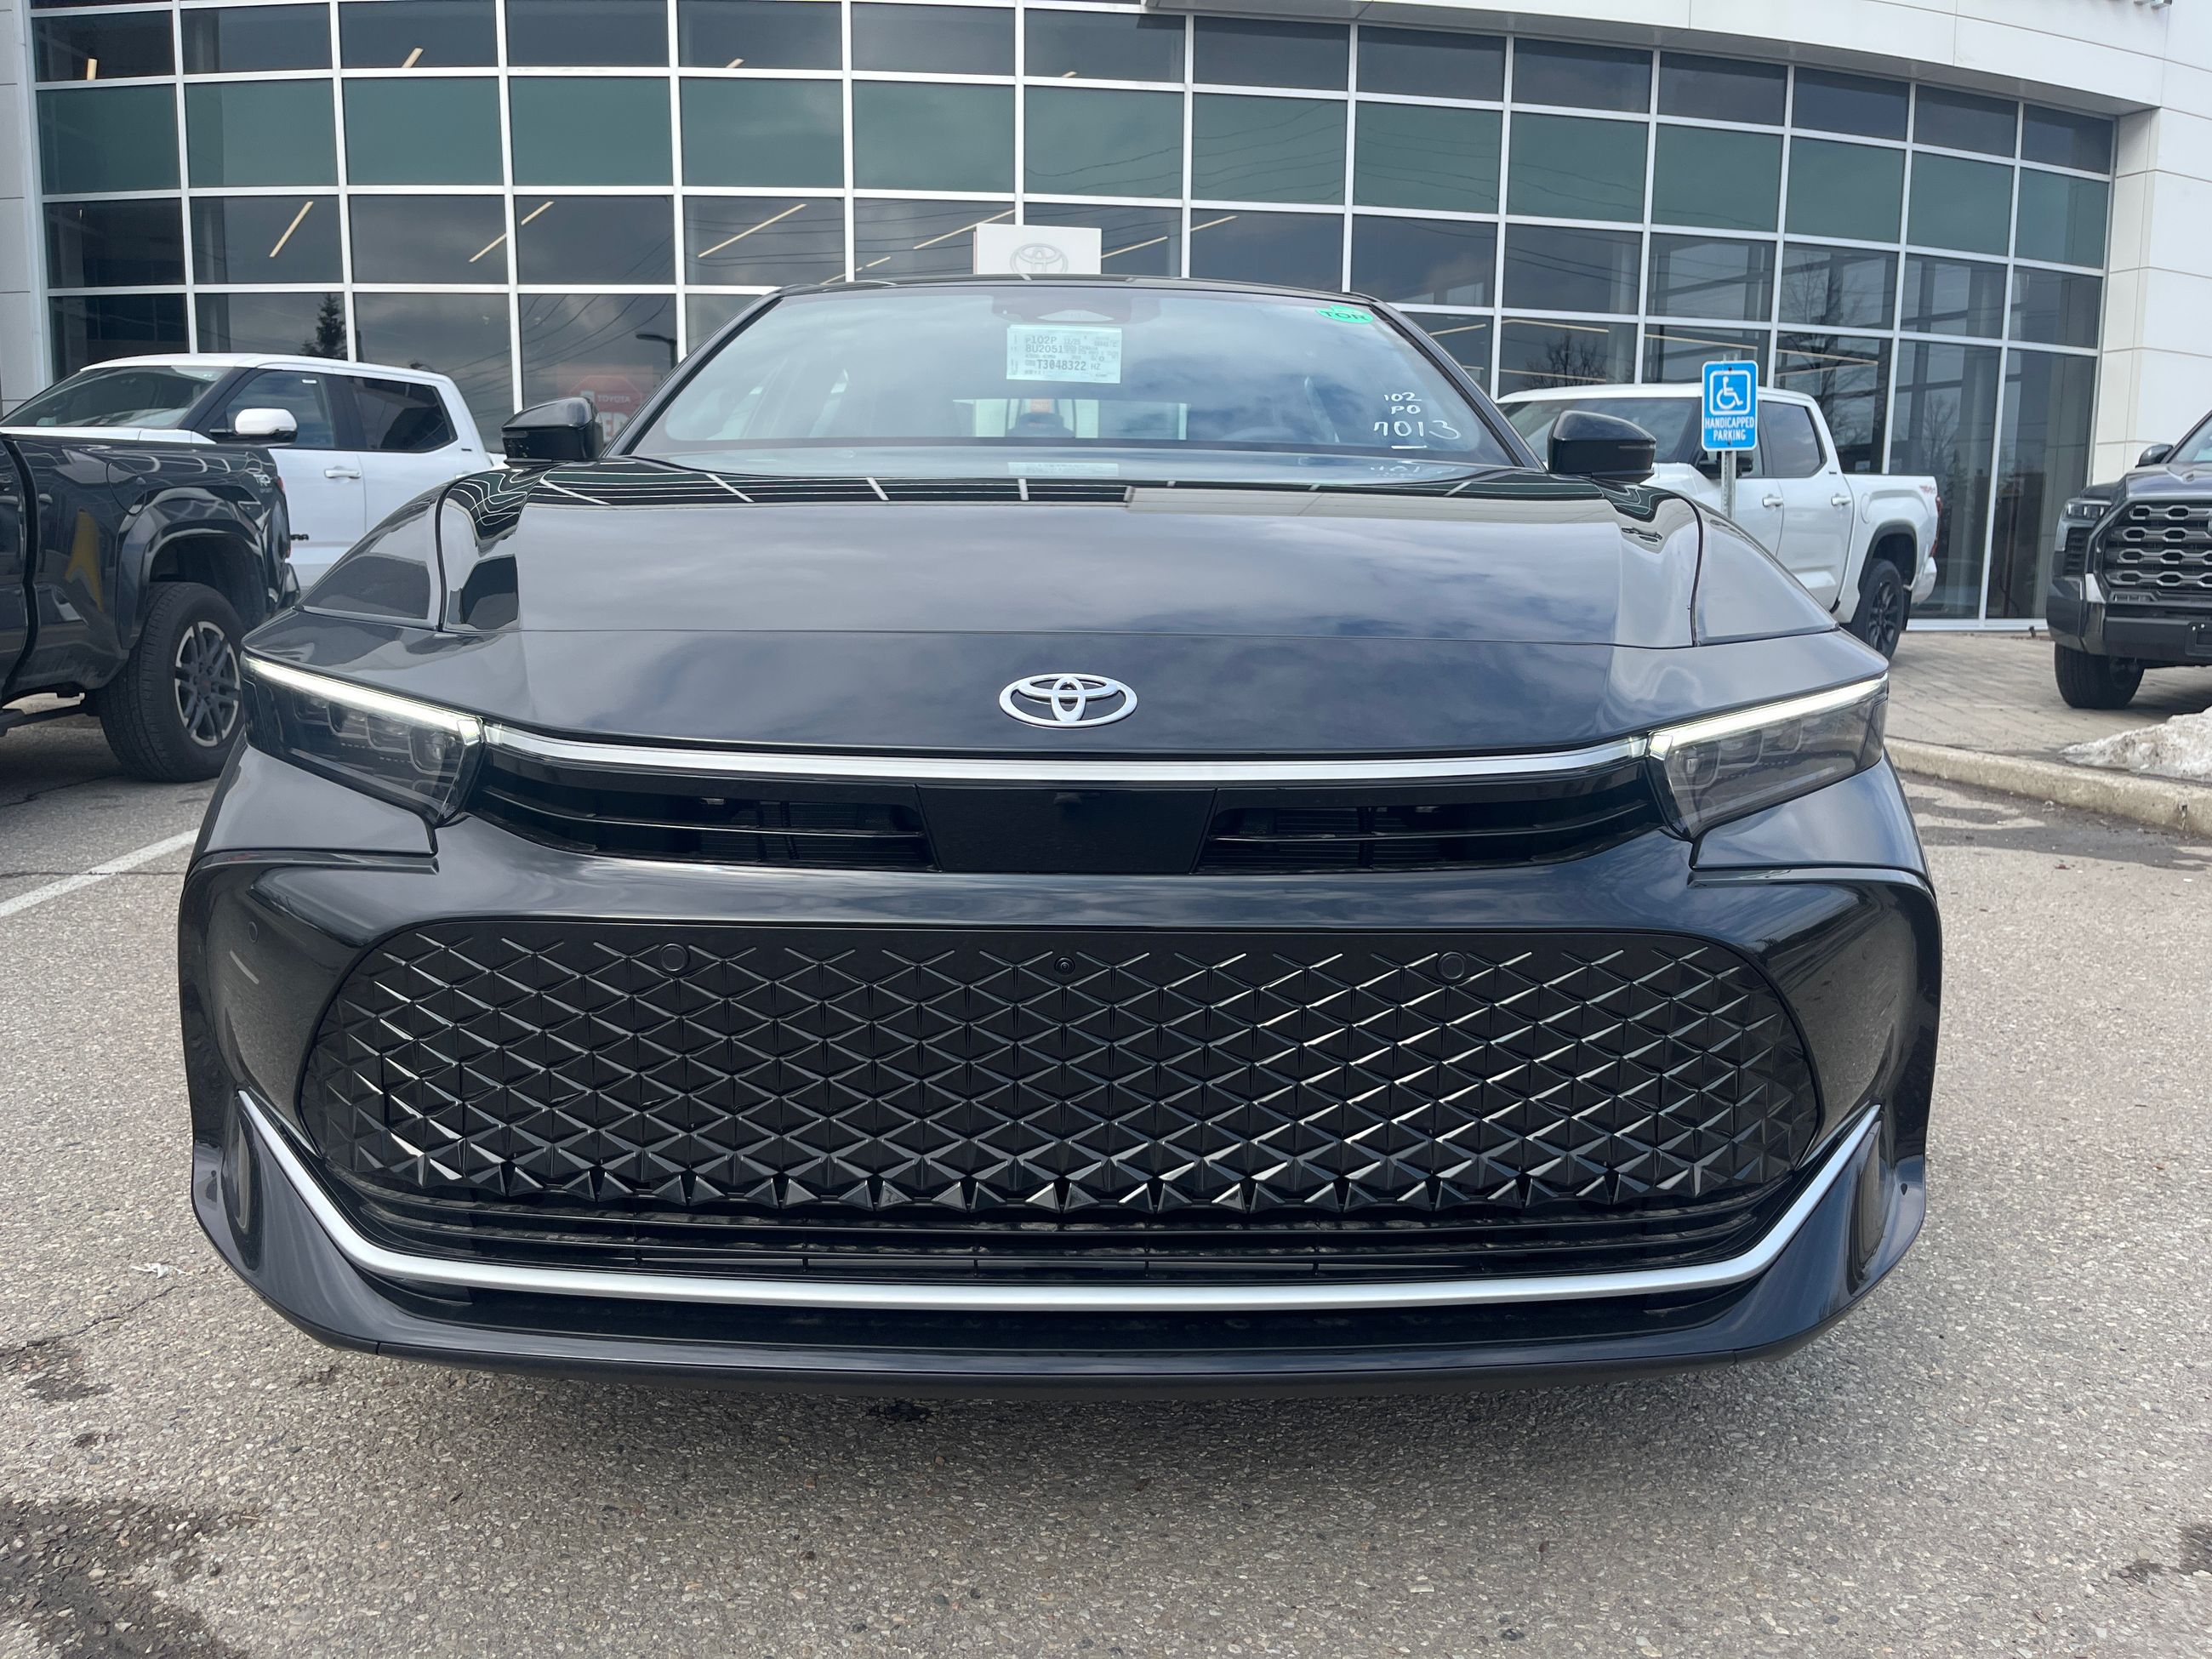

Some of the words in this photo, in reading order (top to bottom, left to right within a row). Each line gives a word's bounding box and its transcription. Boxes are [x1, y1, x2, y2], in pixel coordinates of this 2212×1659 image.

[1037, 359, 1086, 371] T3048322
[598, 394, 630, 403] TOYOTA
[1705, 417, 1755, 429] HANDICAPPED
[1713, 428, 1746, 441] PARKING
